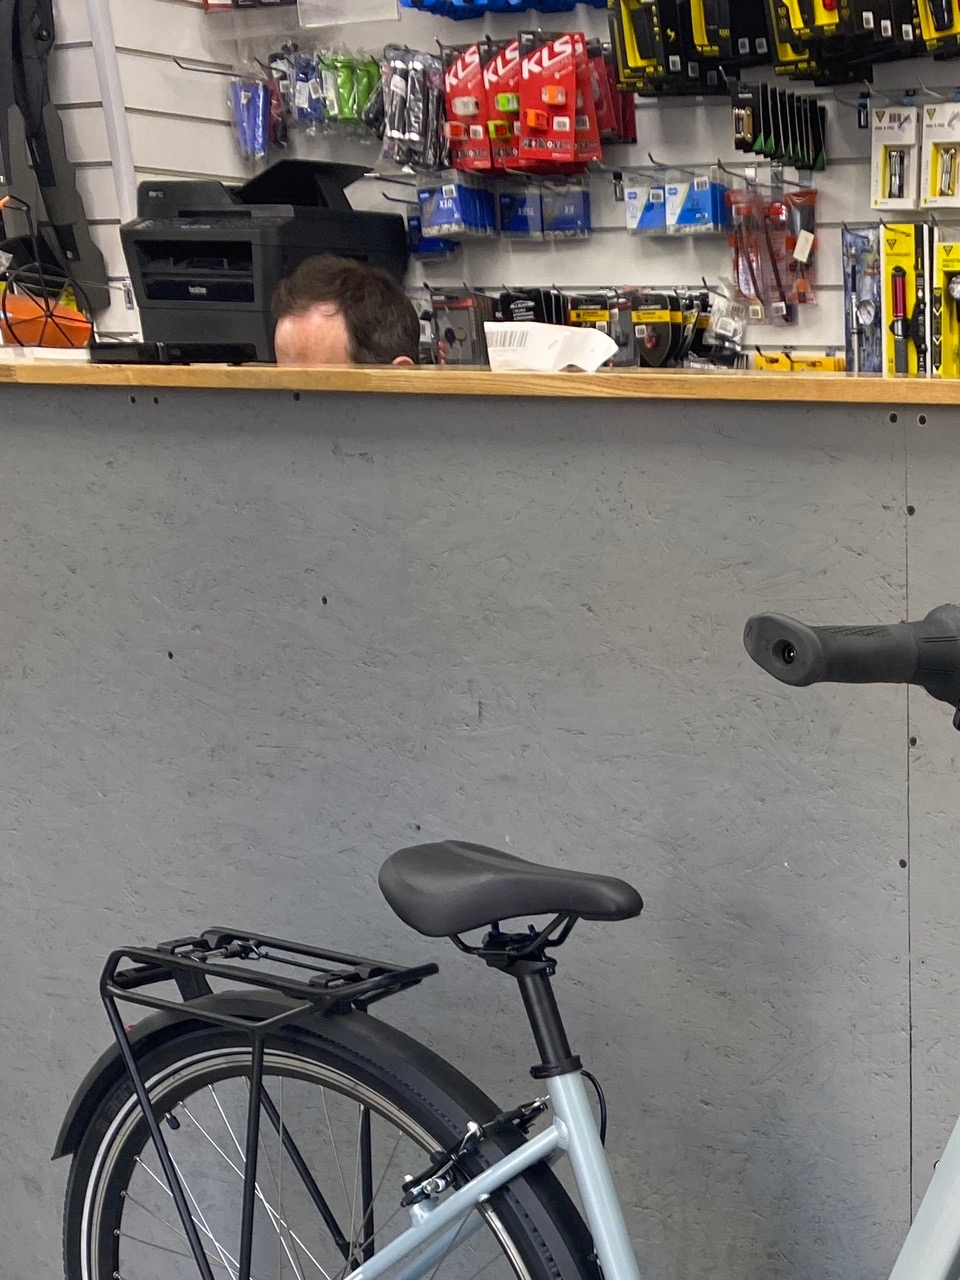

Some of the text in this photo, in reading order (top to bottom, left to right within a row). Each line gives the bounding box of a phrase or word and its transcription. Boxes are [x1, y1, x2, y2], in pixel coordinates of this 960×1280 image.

[445, 46, 480, 93] KLS
[483, 42, 519, 90] KLS
[522, 35, 572, 79] KLS
[439, 199, 453, 209] X10
